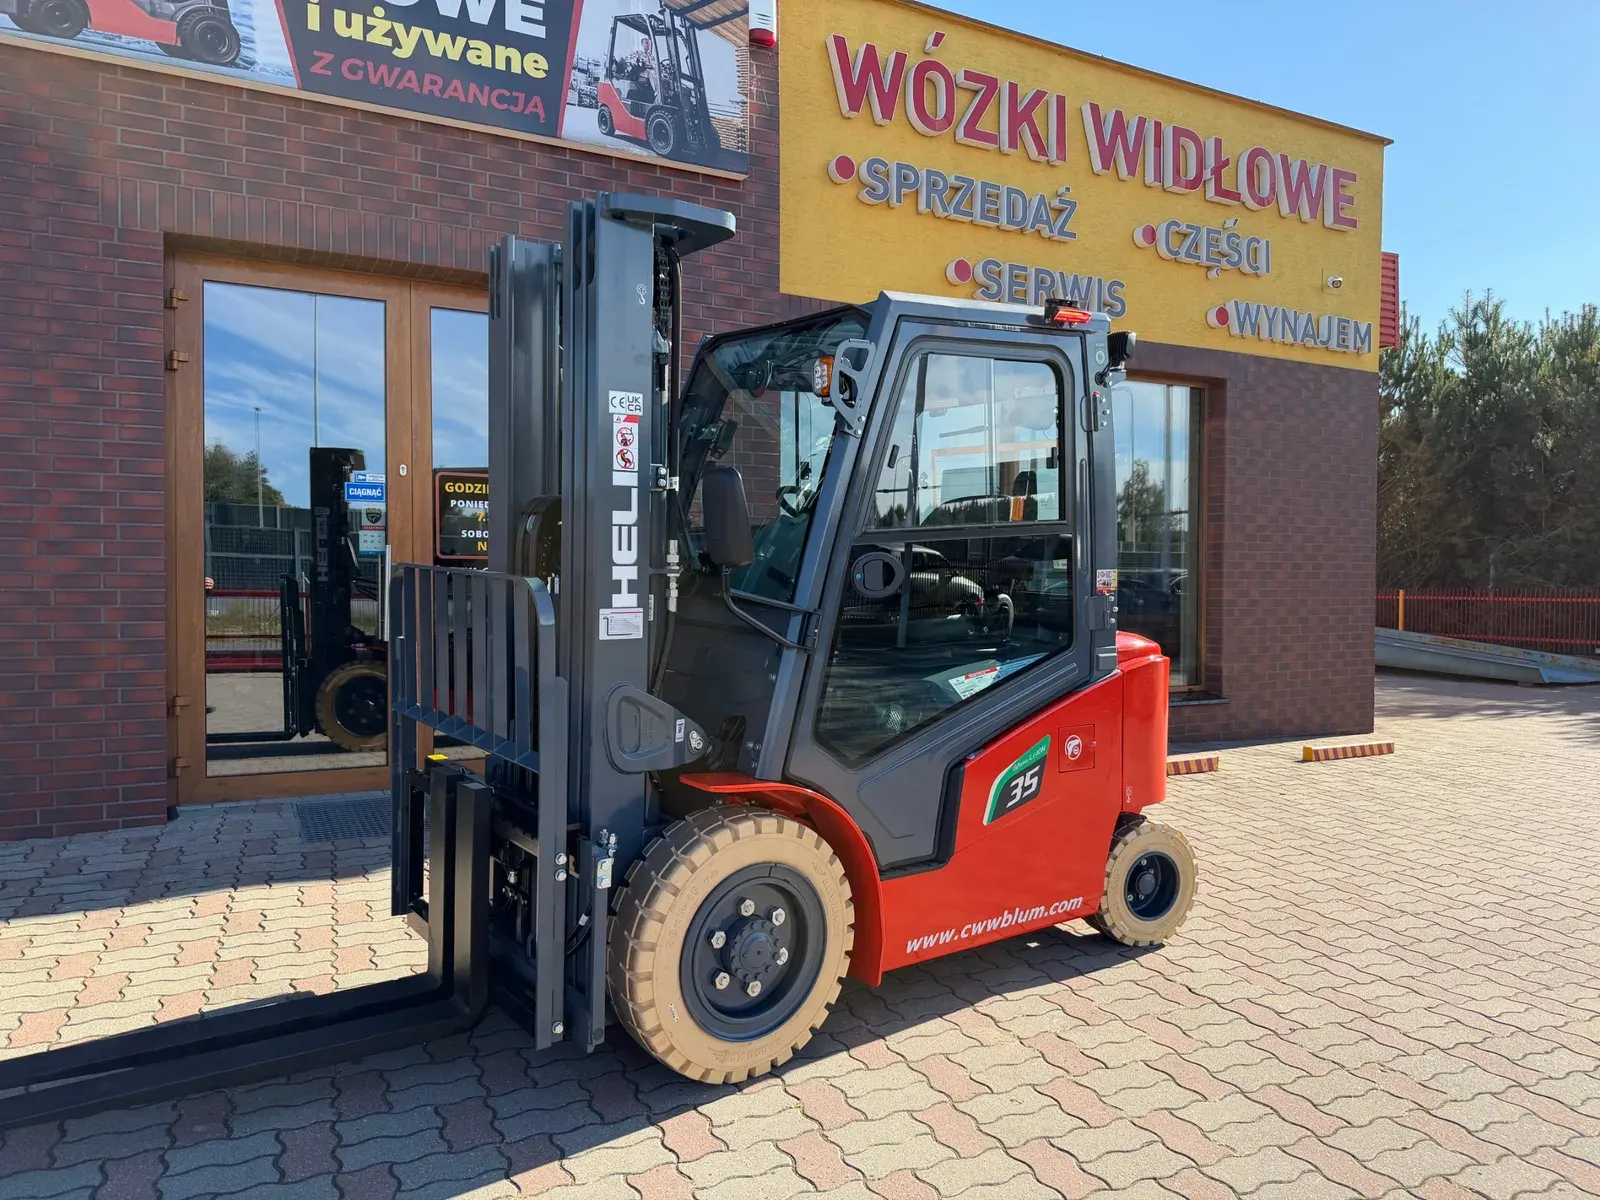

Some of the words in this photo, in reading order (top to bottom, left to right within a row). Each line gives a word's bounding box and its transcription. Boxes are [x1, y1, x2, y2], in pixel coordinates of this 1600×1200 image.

[307, 0, 320, 32] i
[333, 6, 549, 79] używane
[310, 50, 334, 76] Z
[341, 57, 546, 123] GWARANCJĄ
[826, 31, 1067, 166] WÓZKI
[1080, 101, 1359, 232] WIDŁOWE
[858, 157, 1078, 242] SPRZEDAŻ
[1157, 217, 1271, 280] CZĘŚCI
[973, 257, 1127, 319] SERWIS
[1225, 299, 1373, 354] WYNAJEM
[349, 486, 382, 498] CIĄGNĄĆ
[444, 482, 489, 494] GODZI
[612, 471, 638, 608] HELI
[1006, 765, 1041, 809] 35
[906, 896, 1083, 954] www.cwwblum.com
